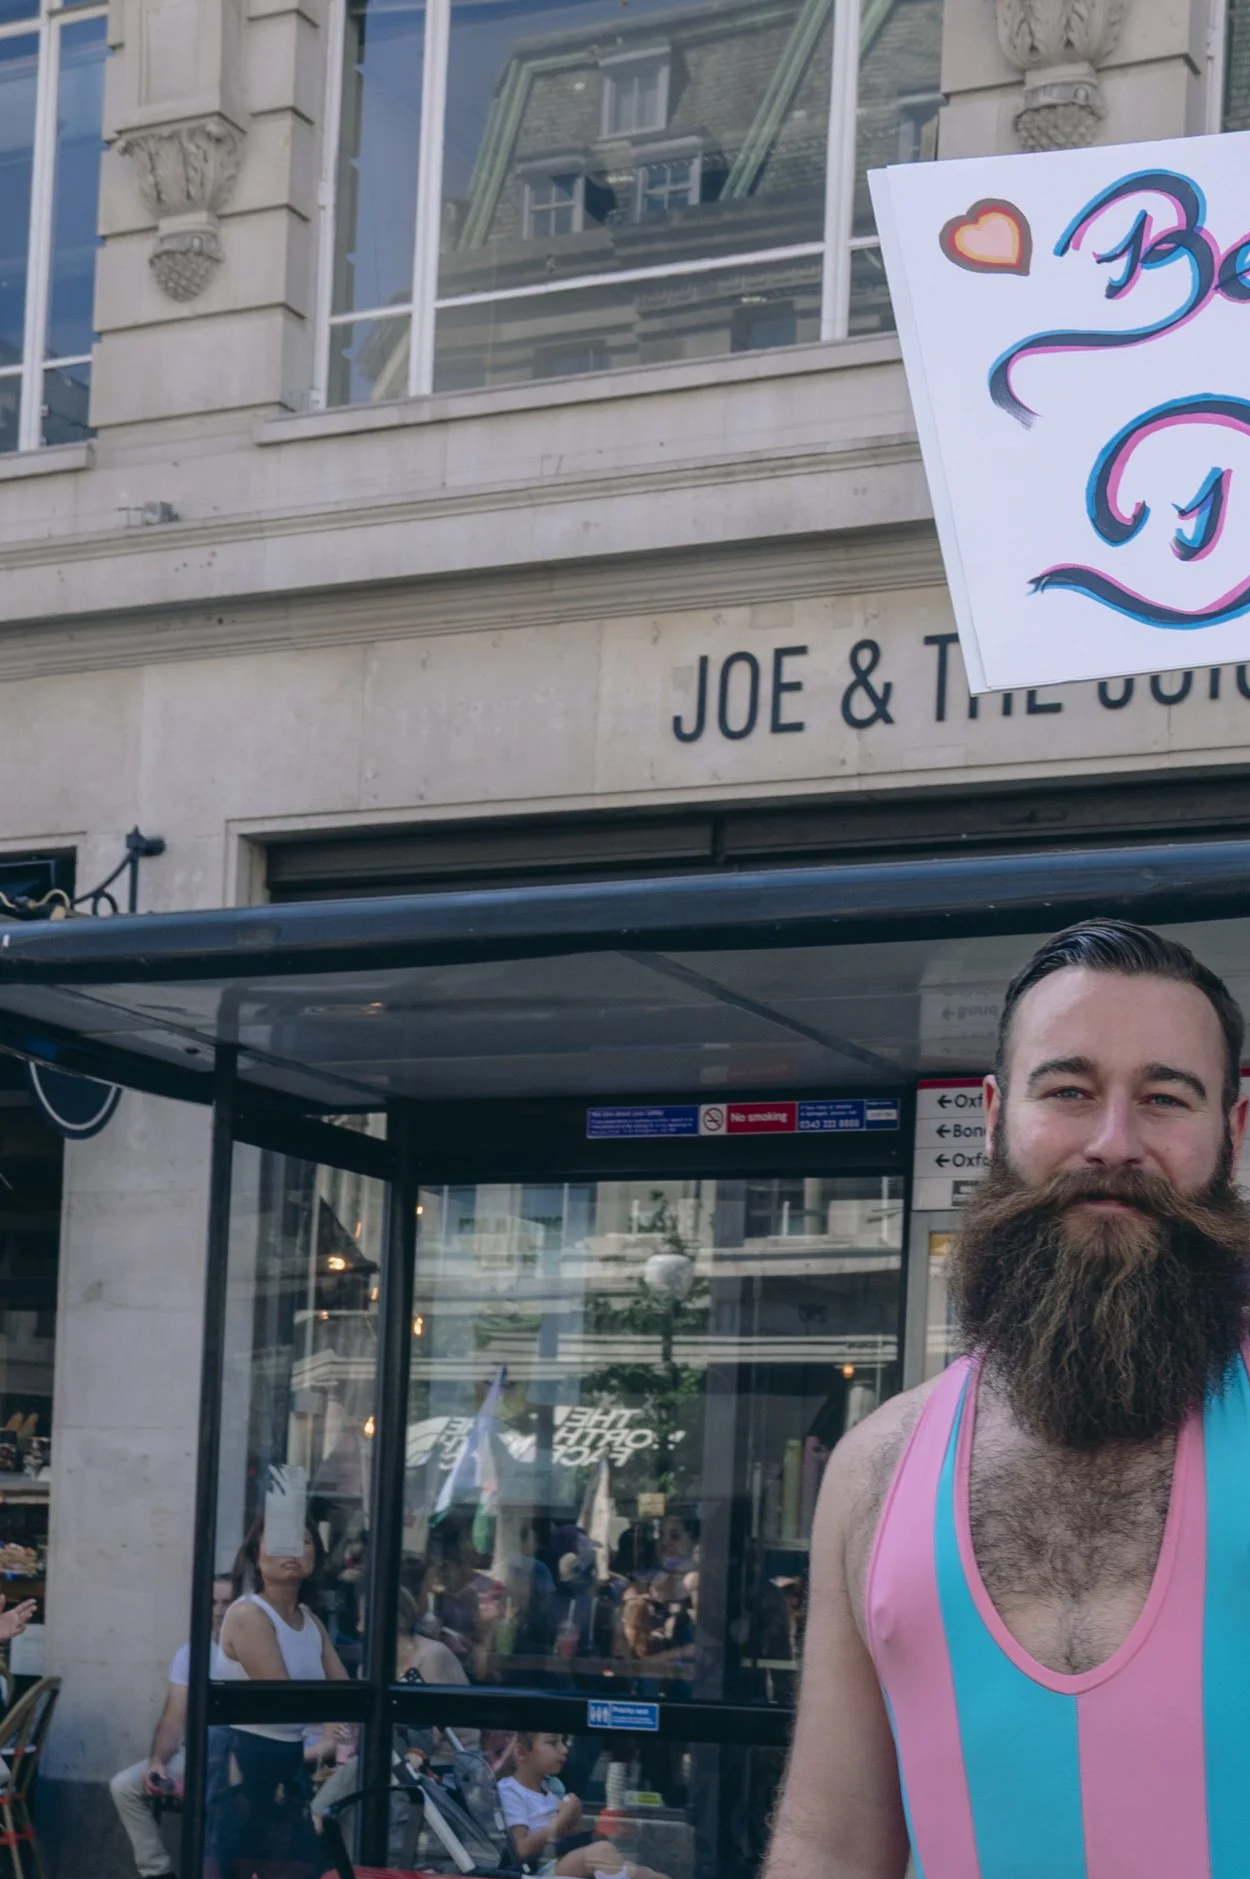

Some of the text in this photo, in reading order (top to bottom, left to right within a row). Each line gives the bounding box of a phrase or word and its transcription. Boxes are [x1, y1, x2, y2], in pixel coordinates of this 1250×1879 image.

[672, 645, 809, 743] JOE
[840, 638, 895, 730] &
[954, 1093, 984, 1108] Oxf
[730, 1111, 788, 1124] No smoking
[952, 1123, 987, 1138] Bon
